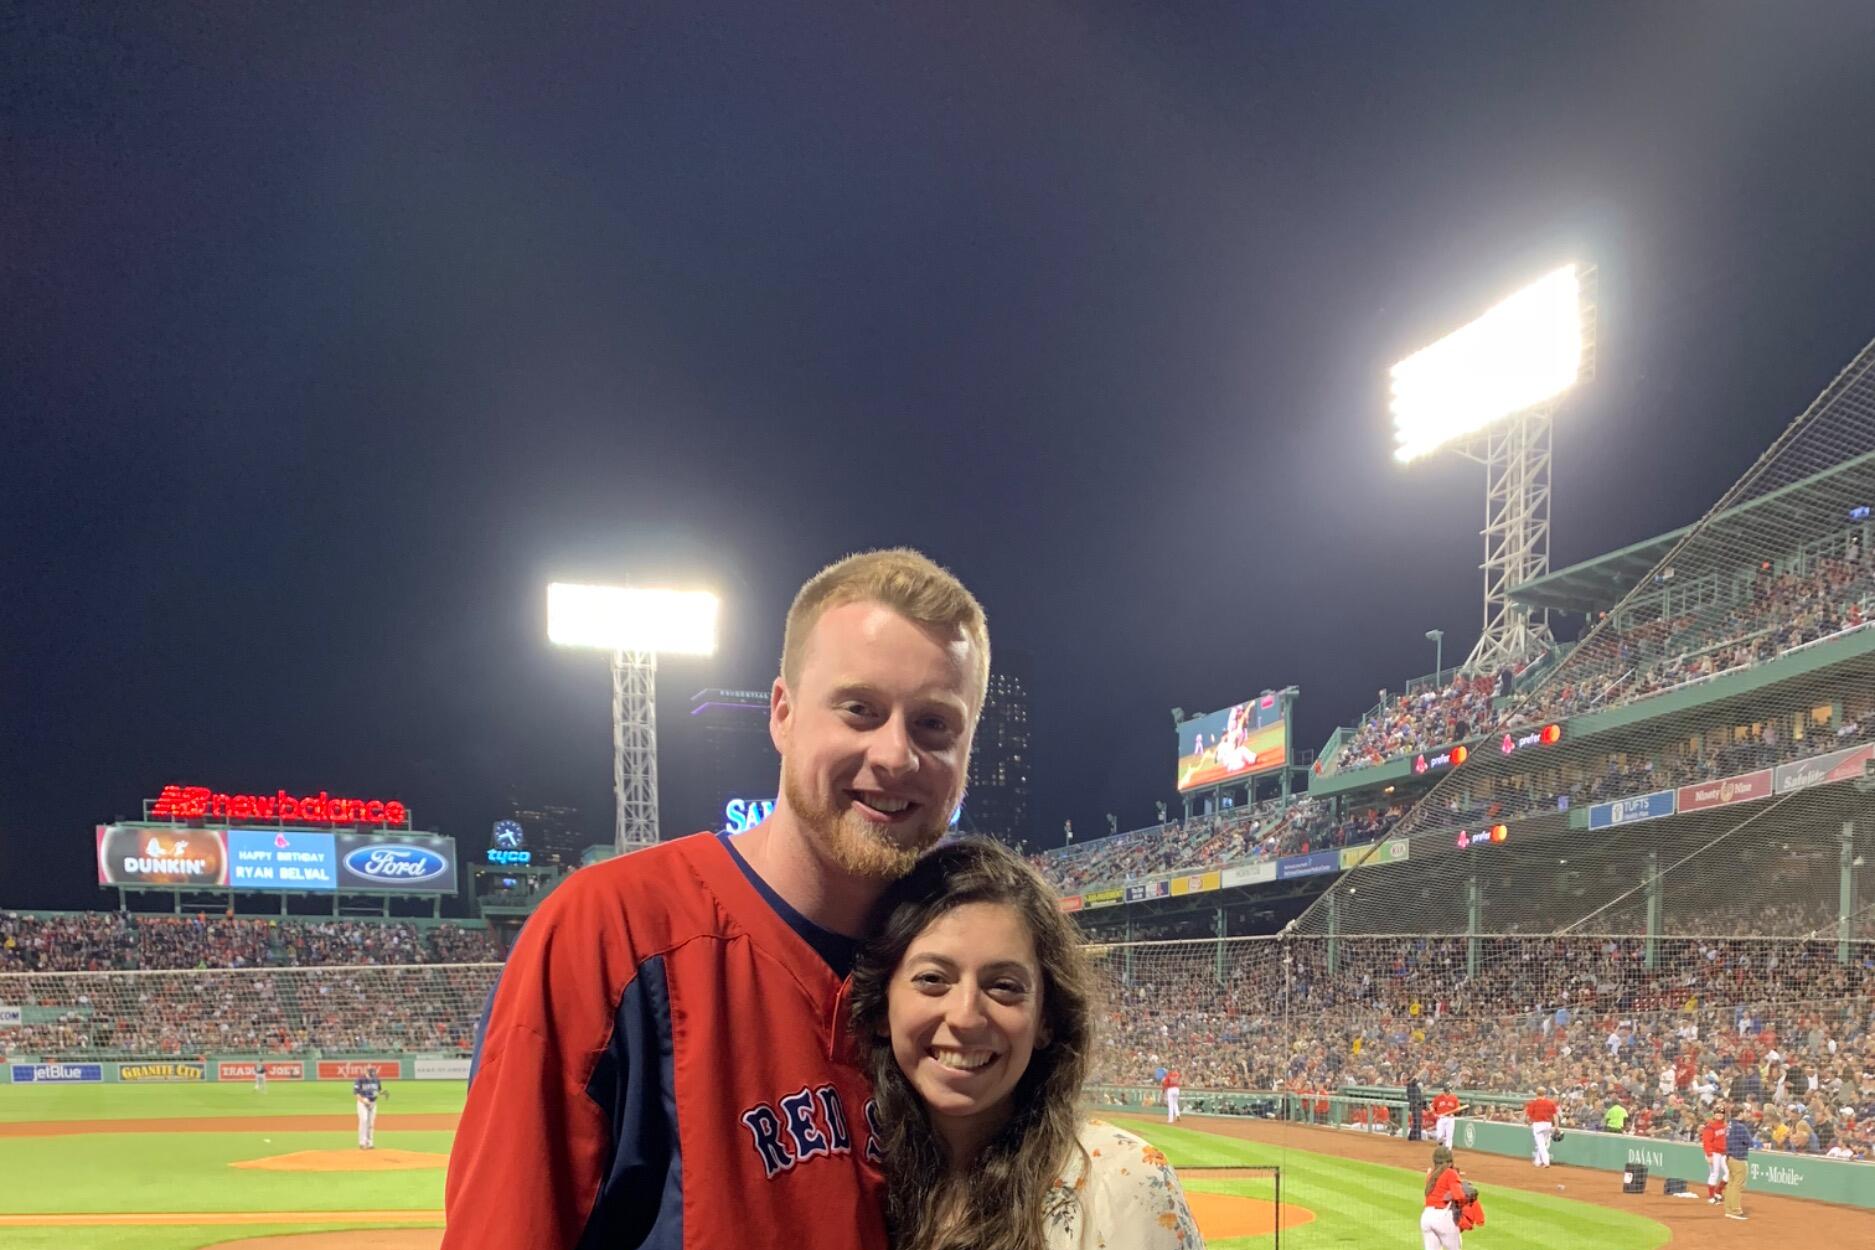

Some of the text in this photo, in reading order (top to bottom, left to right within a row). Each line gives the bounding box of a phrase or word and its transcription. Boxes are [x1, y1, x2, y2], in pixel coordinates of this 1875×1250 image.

[1519, 734, 1541, 748] prefer
[1430, 753, 1450, 768] prefer
[1472, 830, 1491, 844] prefer
[239, 851, 324, 862] HAPPY BIRTHDAY
[365, 850, 427, 875] Ford
[487, 849, 531, 864] tyco
[236, 866, 274, 879] RYAN
[32, 1065, 81, 1081] jetBlue
[121, 1065, 204, 1079] GRANITE CITY
[336, 1062, 382, 1078] xfini
[742, 1085, 851, 1180] RED
[1627, 1147, 1663, 1167] DASANI
